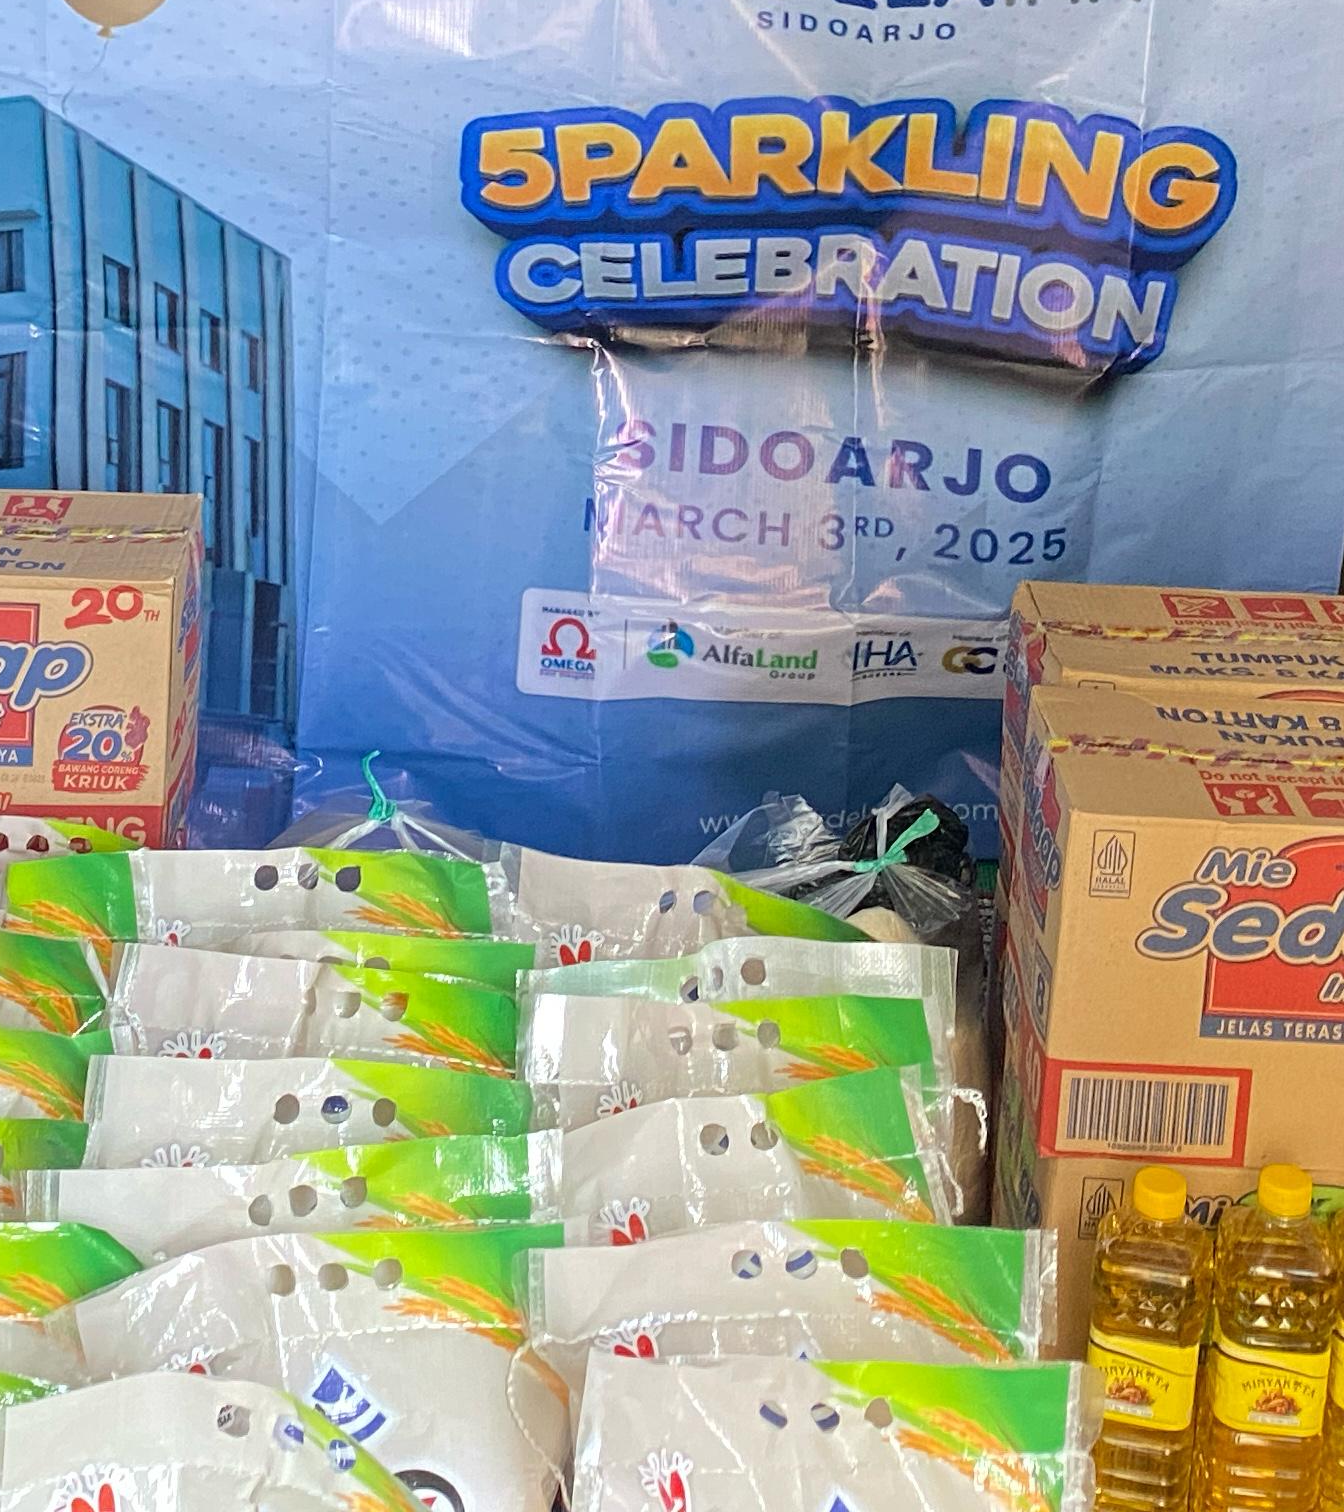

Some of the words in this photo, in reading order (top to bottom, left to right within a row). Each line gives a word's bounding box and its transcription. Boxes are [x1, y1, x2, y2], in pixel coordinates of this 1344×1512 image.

[757, 10, 957, 43] SIDOARJO
[478, 111, 1222, 231] 5PARKLING
[508, 238, 1168, 349] CELEBRATION
[617, 416, 1054, 505] SIDOARJO
[583, 496, 791, 551] MARCH
[932, 524, 1067, 566] 2025
[541, 658, 595, 673] OMEGA
[702, 644, 817, 670] AlfaLand
[769, 671, 816, 681] Group
[1157, 707, 1308, 728] KARTON
[58, 764, 100, 773] BAWANG
[101, 766, 139, 775] GORENG
[1199, 770, 1224, 781] Do
[1229, 771, 1260, 783] not
[1265, 774, 1324, 789] accept
[63, 775, 128, 789] KRIUK
[1198, 850, 1292, 885] Mie
[1216, 1019, 1274, 1037] JELAS
